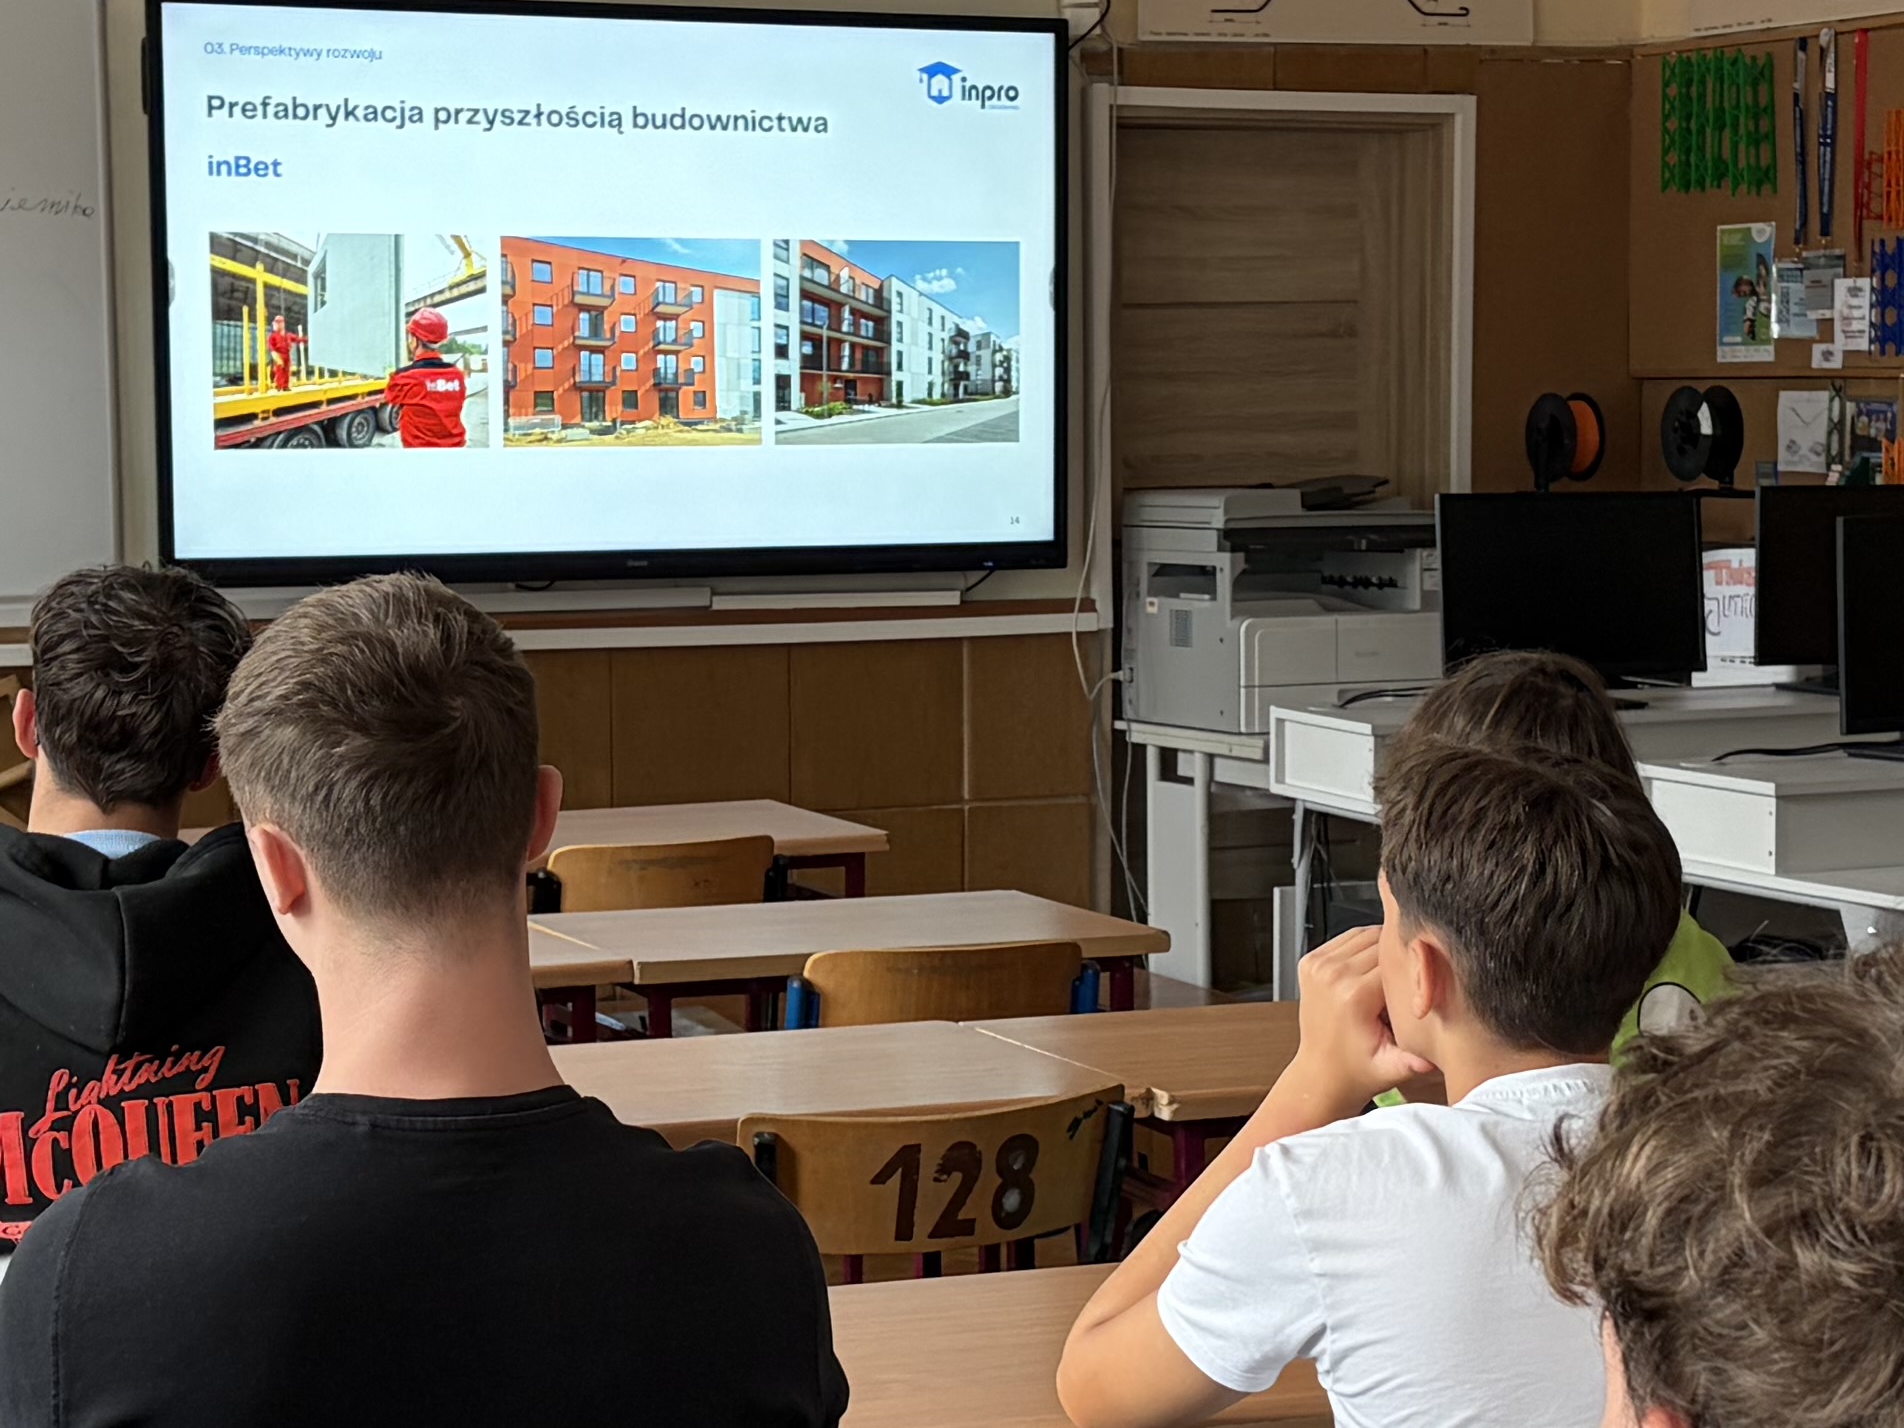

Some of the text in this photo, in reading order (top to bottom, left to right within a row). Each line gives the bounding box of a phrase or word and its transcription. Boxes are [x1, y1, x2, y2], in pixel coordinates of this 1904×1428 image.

[203, 42, 383, 63] 03. Perspektywy rozwoju
[960, 76, 1020, 110] inpro
[206, 94, 829, 135] Prefabrykacja przyszłością budownictwa
[207, 154, 283, 178] inBet
[28, 1044, 226, 1139] Lightning
[869, 1133, 1039, 1242] 128
